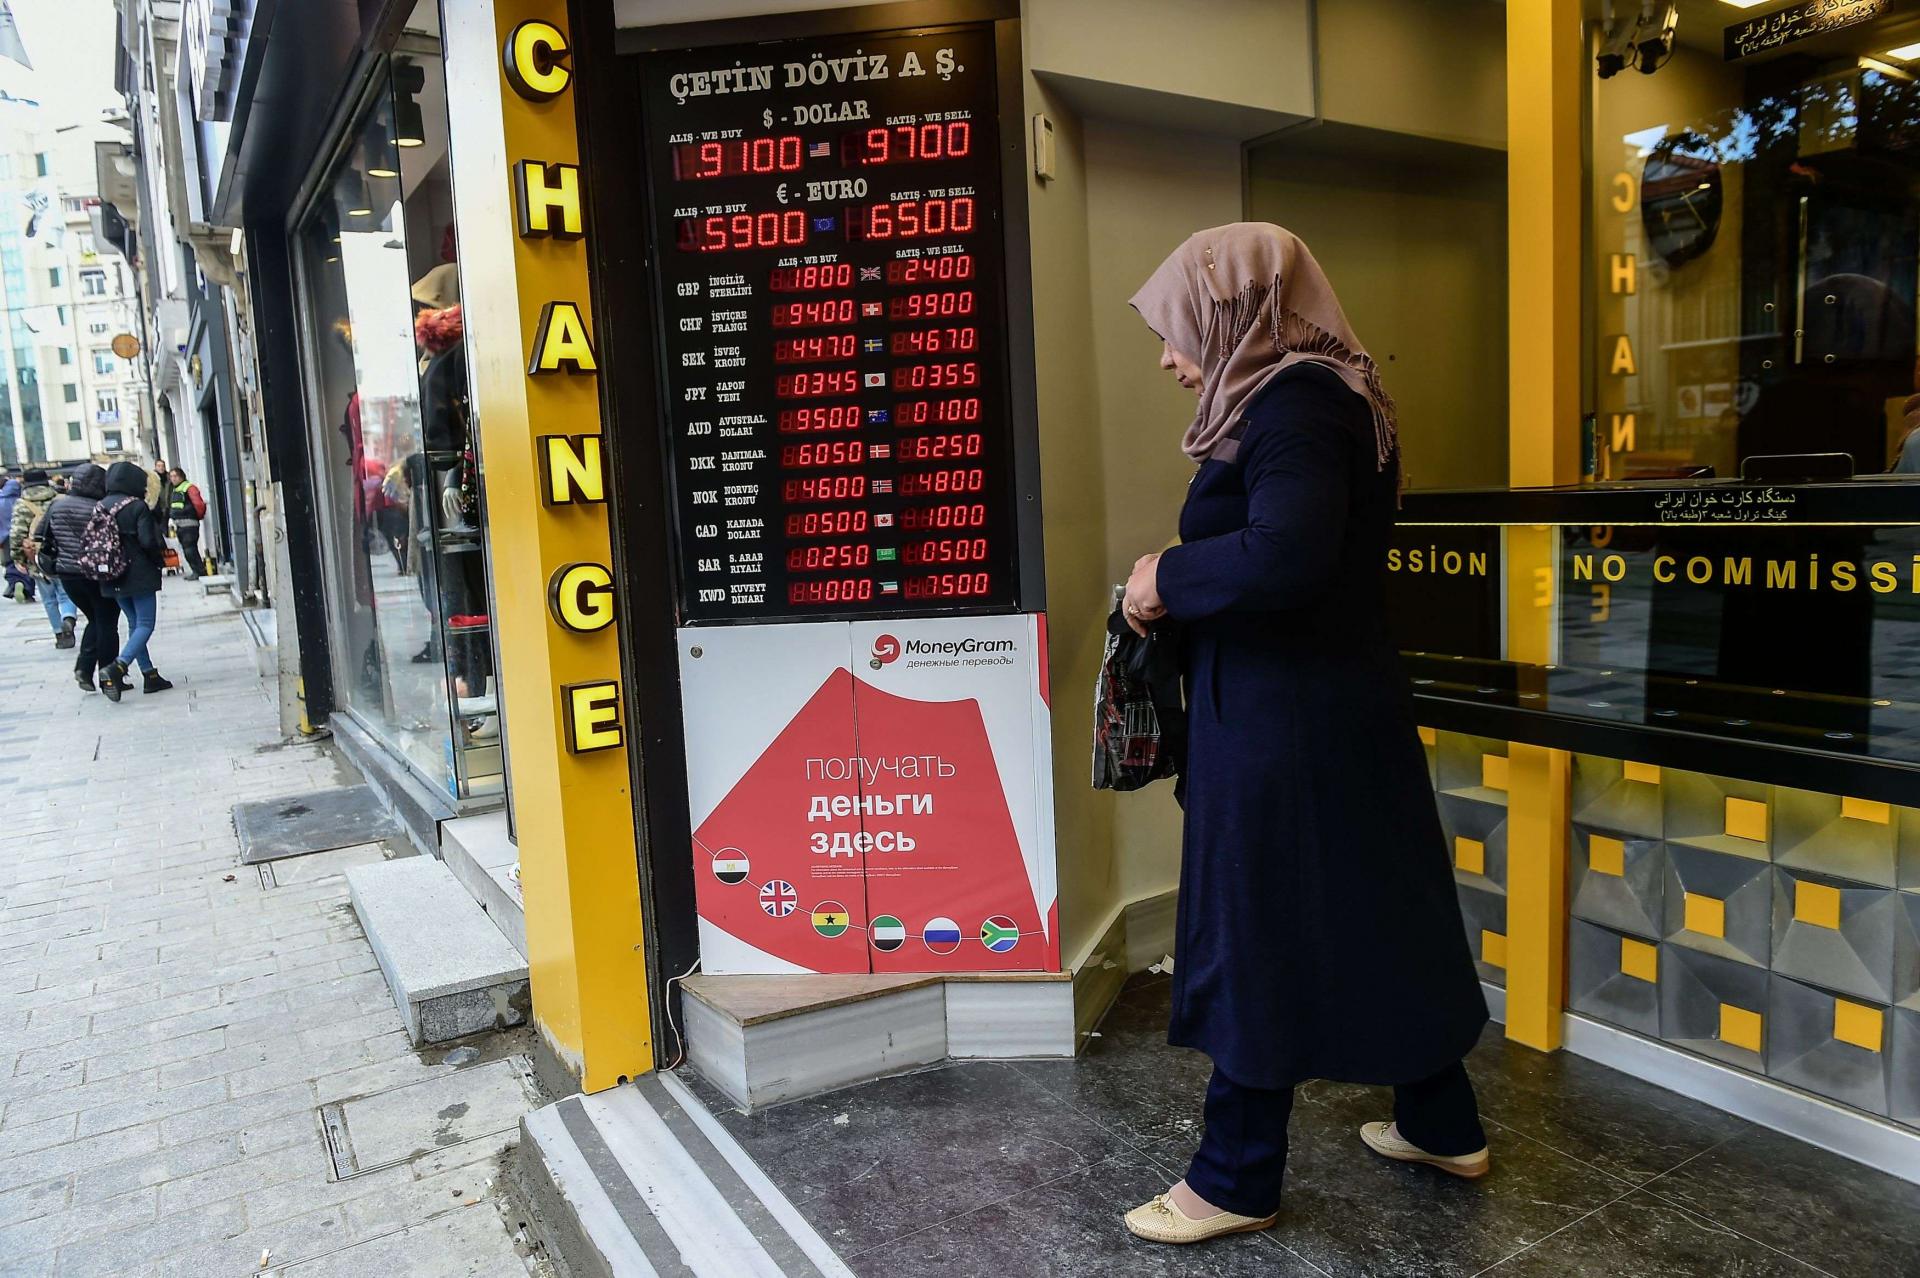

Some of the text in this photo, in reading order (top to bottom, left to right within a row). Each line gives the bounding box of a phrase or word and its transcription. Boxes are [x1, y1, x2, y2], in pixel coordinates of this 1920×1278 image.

[670, 49, 964, 105] ÇETİN DÖVİZ A Ş.
[793, 100, 870, 125] DOLAR
[887, 115, 916, 125] SATIŞ
[925, 113, 941, 121] WE
[945, 111, 971, 120] SELL
[669, 133, 693, 143] ALIŞ
[701, 131, 718, 140] WE
[721, 129, 742, 138] BUY
[807, 178, 867, 201] EURO
[891, 191, 920, 201] SATIŞ
[929, 189, 945, 197] WE
[949, 187, 974, 196] SELL
[674, 208, 697, 218] ALIŞ
[706, 206, 722, 214] WE
[725, 204, 747, 213] BUY
[896, 249, 920, 258] SATIŞ
[927, 247, 940, 255] WE
[943, 245, 964, 254] SELL
[778, 258, 797, 267] ALIŞ
[804, 256, 817, 264] WE
[820, 254, 837, 263] BUY
[904, 255, 969, 280] 2400
[709, 274, 744, 286] İNGİLİZ
[796, 265, 850, 288] 1800
[677, 282, 699, 296] GBP
[710, 285, 752, 297] STERLİNİ
[909, 292, 972, 316] 9900
[712, 311, 747, 326] İSVİÇRE
[791, 300, 852, 324] 9400
[680, 318, 702, 331] CHF
[793, 336, 854, 357] 4470
[911, 328, 973, 351] 4670
[714, 347, 739, 357] İSVEÇ
[682, 353, 705, 366] SEK
[715, 358, 746, 367] KRONU
[912, 364, 975, 386] 0355
[503, 19, 624, 755] CHANGE
[717, 381, 745, 391] JAPON
[794, 371, 856, 394] 0345
[685, 387, 706, 401] JPY
[914, 399, 977, 422] 0100
[719, 415, 767, 425] AVUSTRAL.
[798, 407, 859, 430] 9500
[688, 422, 711, 435] AUD
[800, 442, 861, 464] 6050
[917, 435, 979, 457] 6250
[690, 456, 715, 469] DKK
[722, 462, 753, 471] KRONU
[803, 477, 864, 498] 4600
[920, 470, 981, 491] 4800
[724, 485, 758, 495] NORVEÇ
[693, 491, 718, 504] NOK
[725, 496, 755, 505] KRONU
[805, 511, 866, 533] 0500
[930, 505, 983, 526] 1000
[727, 519, 764, 528] KANADA
[696, 525, 717, 537] CAD
[729, 553, 763, 562] S. ARAB
[807, 545, 868, 567] 0250
[923, 540, 985, 561] 0500
[698, 559, 721, 571] SAR
[1573, 554, 1626, 582] NO
[731, 584, 766, 593] KUVEYT
[811, 580, 870, 600] 4000
[929, 574, 987, 594] 7500
[699, 589, 725, 602] KWD
[906, 655, 1014, 669] денежные переводы
[806, 754, 957, 786] получать
[807, 793, 934, 822] деньги
[810, 830, 916, 858] здесь
